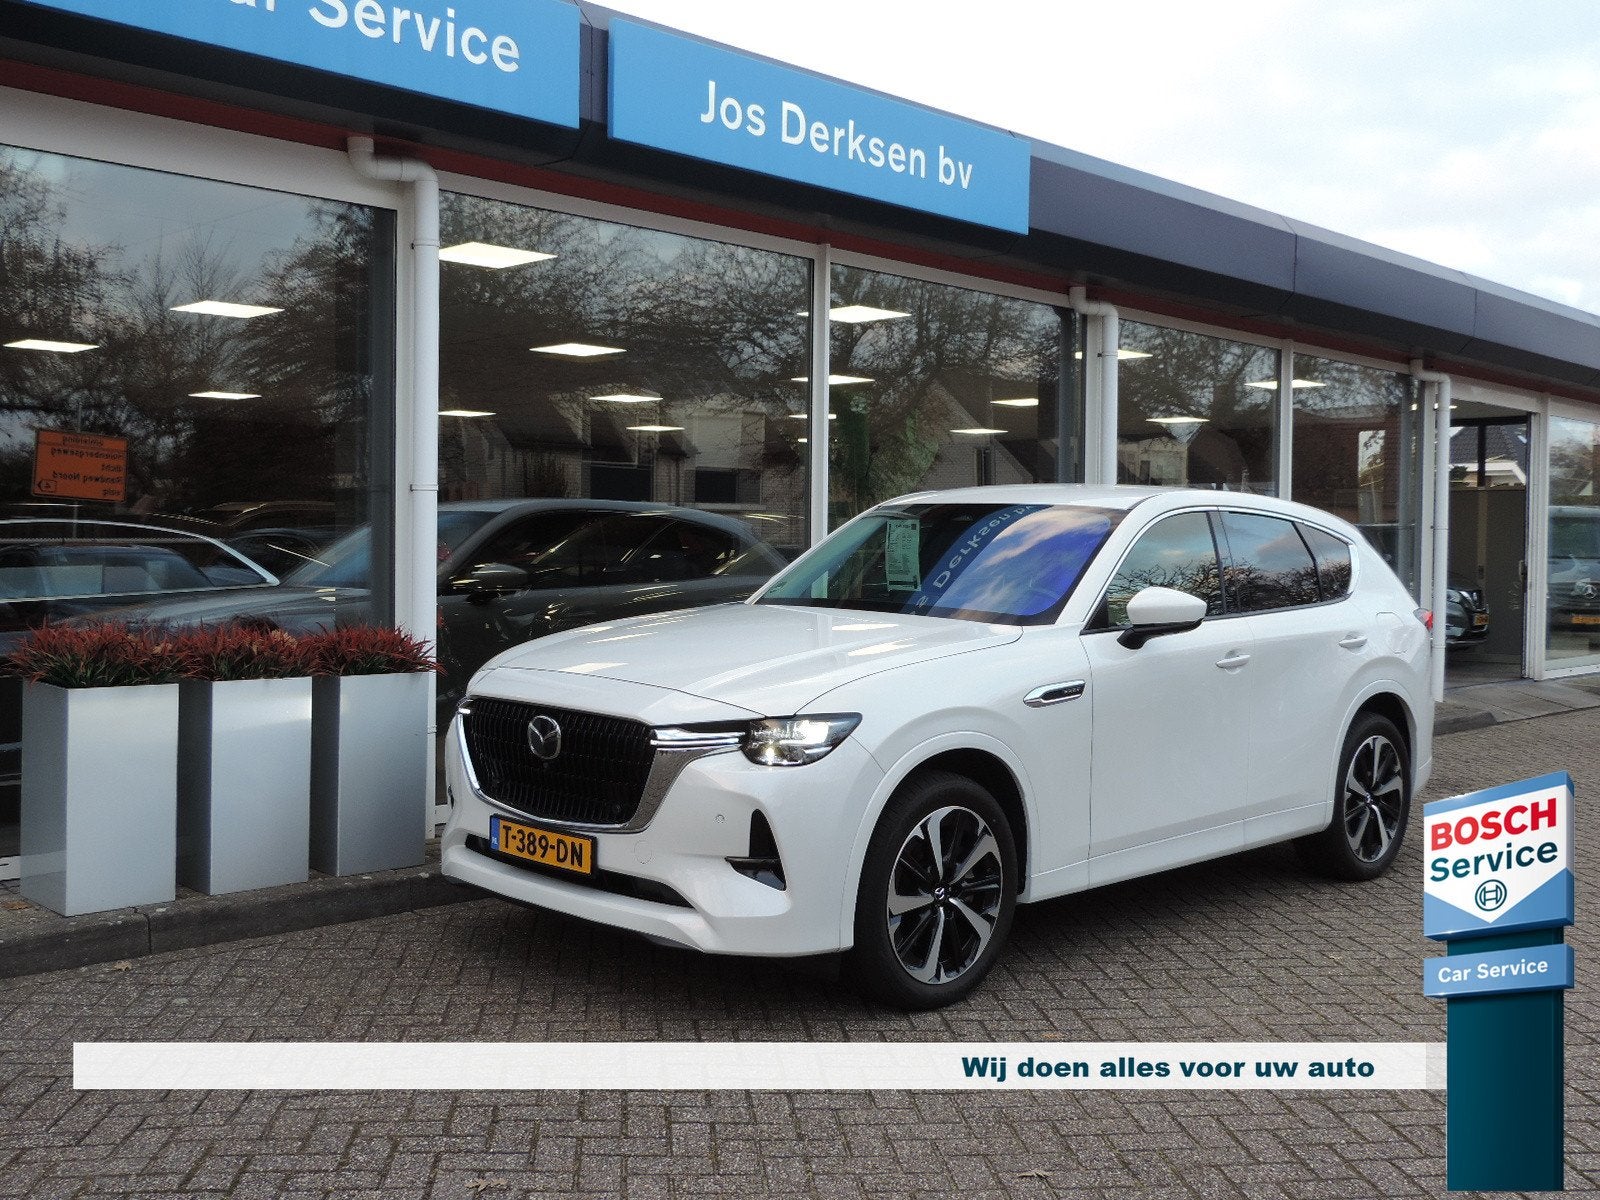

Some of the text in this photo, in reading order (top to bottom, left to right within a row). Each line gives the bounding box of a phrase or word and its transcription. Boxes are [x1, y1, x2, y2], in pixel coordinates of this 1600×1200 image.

[308, 0, 520, 73] Service
[700, 80, 973, 190] Jos Derksen bv
[502, 824, 583, 868] T-389-DN
